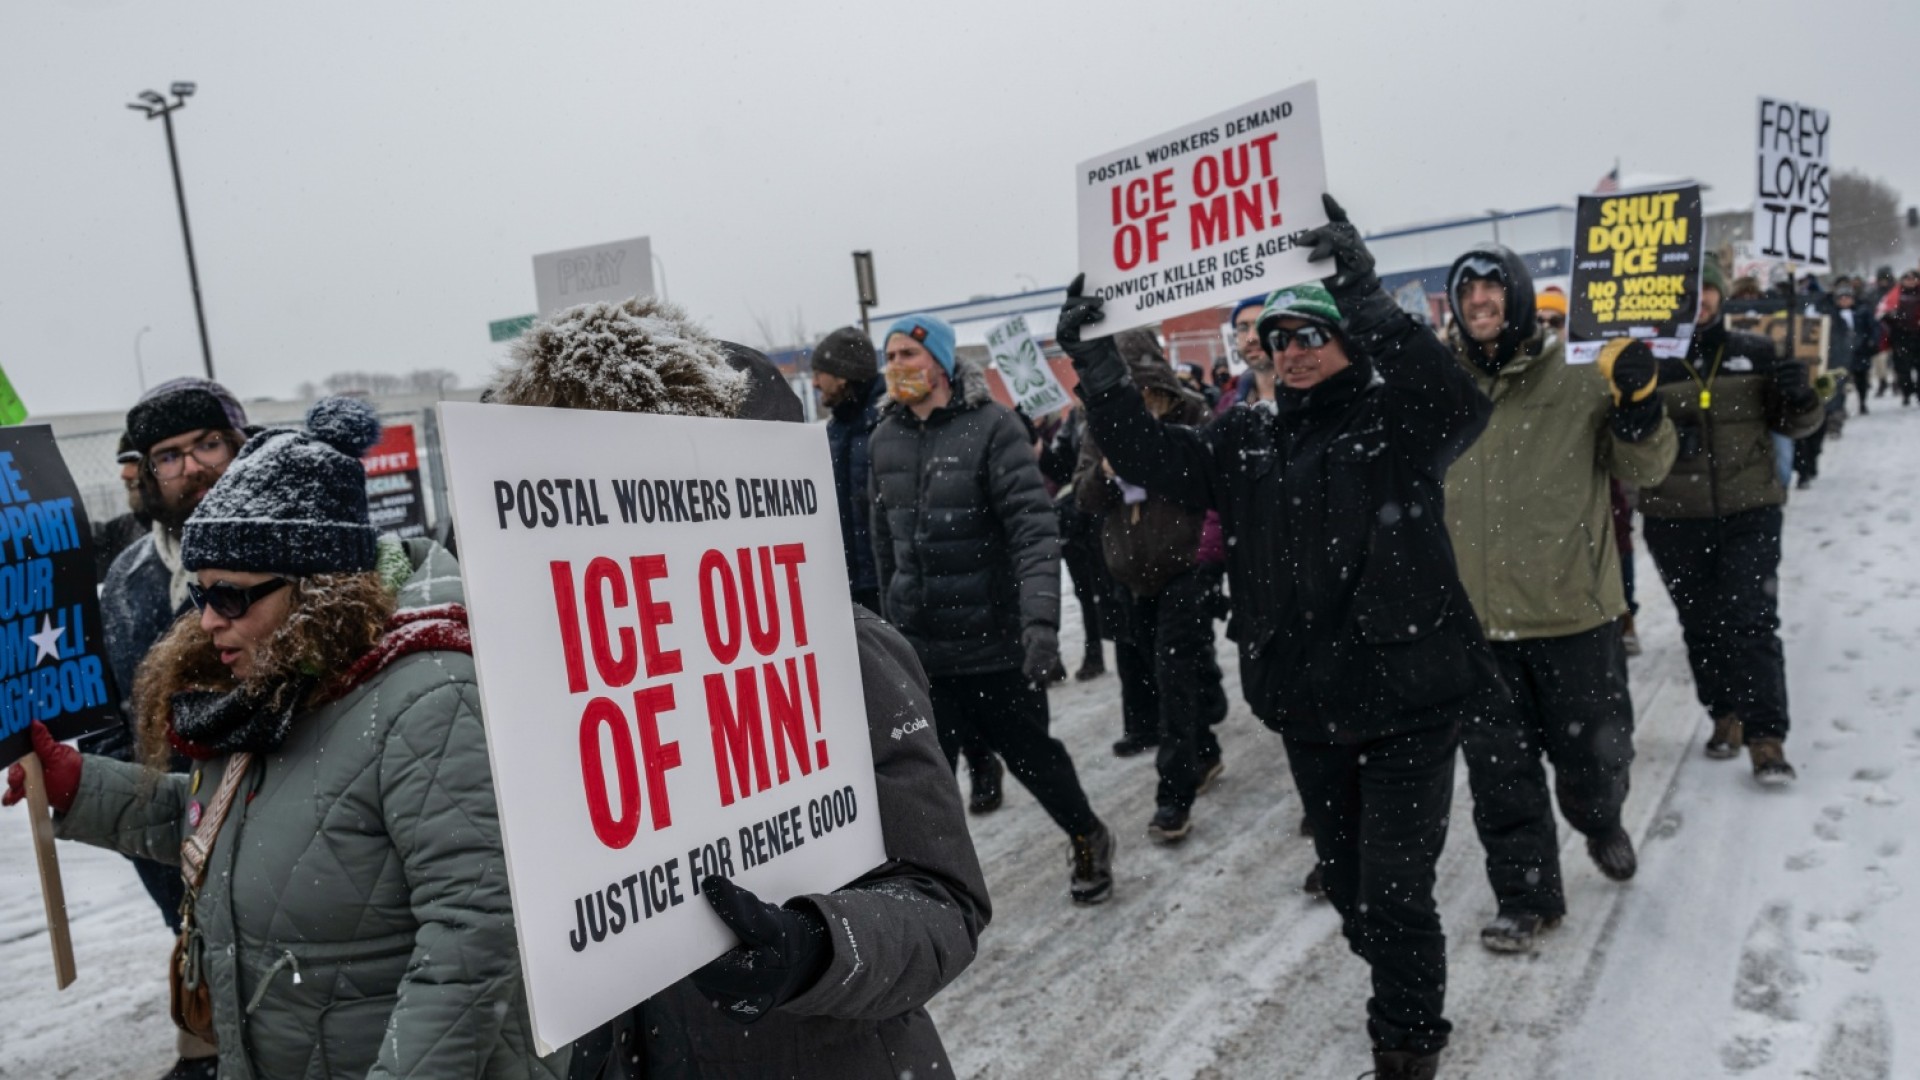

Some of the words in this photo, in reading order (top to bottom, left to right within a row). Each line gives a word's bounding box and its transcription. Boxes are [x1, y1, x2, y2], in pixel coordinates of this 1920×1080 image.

[1088, 155, 1142, 186] POSTAL
[1146, 128, 1220, 166] WORKERS
[1226, 101, 1293, 139] DEMAND
[1759, 100, 1830, 158] FREY
[1111, 168, 1177, 226] ICE
[1192, 132, 1279, 198] OUT
[1758, 154, 1830, 208] LOVES
[1113, 213, 1170, 272] OF
[1189, 177, 1283, 251] MN!
[1588, 217, 1688, 253] DOWN
[1600, 193, 1680, 227] SHUT
[1762, 203, 1829, 265] ICE
[557, 249, 626, 294] PRAY
[1095, 272, 1158, 304] CONVICT
[1163, 256, 1217, 284] KILLER
[1223, 246, 1250, 269] ICE
[1135, 274, 1216, 311] JONATHAN
[1222, 261, 1266, 288] ROSS
[1588, 281, 1618, 300] NO
[1623, 275, 1685, 295] WORK
[1612, 247, 1658, 277] ICE
[1592, 299, 1616, 314] NO
[1619, 295, 1679, 310] SCHOOL
[1597, 312, 1615, 323] NO
[987, 328, 1004, 347] WE
[1005, 316, 1027, 338] ARE
[1022, 384, 1062, 411] AMILY
[494, 479, 609, 530] POSTAL
[612, 478, 731, 524] WORKERS
[736, 477, 819, 519] DEMAND
[549, 553, 684, 694] ICE
[698, 543, 808, 664] OUT
[579, 683, 682, 850] OF
[703, 653, 830, 808] MN!
[568, 857, 684, 952] JUSTICE
[688, 836, 735, 896] FOR
[739, 805, 805, 871] RENEE
[808, 785, 858, 839] GOOD
